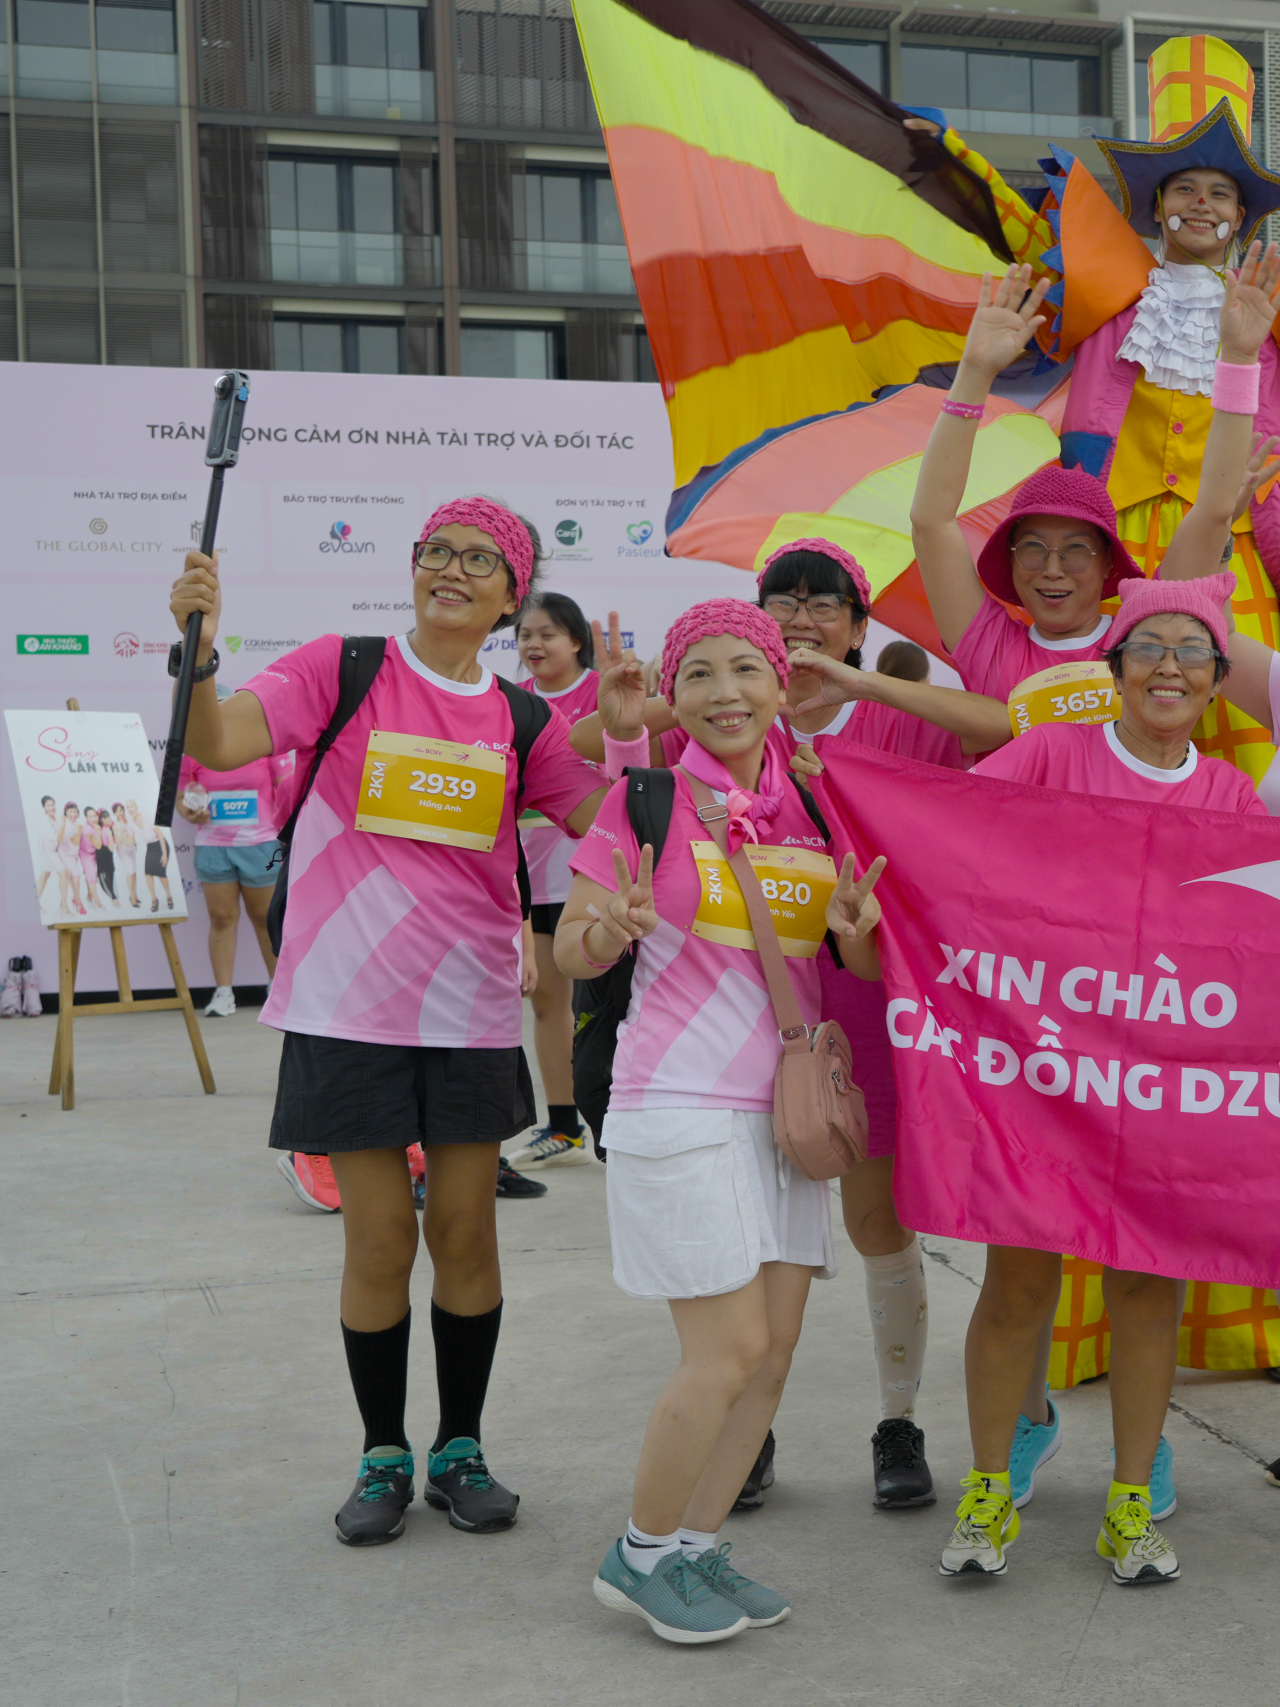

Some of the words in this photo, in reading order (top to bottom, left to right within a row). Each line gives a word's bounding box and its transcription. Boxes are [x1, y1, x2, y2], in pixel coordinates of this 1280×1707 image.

[147, 422, 205, 440] TRÂN
[240, 427, 287, 445] ỌNG
[294, 424, 341, 443] CẢM
[348, 428, 378, 444] ƠN
[386, 427, 431, 445] NHÀ
[437, 429, 467, 446] TÀI
[474, 431, 515, 450] TRỢ
[521, 430, 548, 447] VÀ
[554, 430, 590, 448] ĐỐI
[597, 432, 634, 449] TÁC
[74, 490, 96, 499] NHÀ
[99, 491, 114, 499] TÀI
[118, 491, 138, 501] TRỢ
[140, 492, 158, 501] ĐỊA
[283, 493, 305, 503] BẢO
[307, 495, 327, 505] TRỢ
[371, 496, 405, 504] THÔNG
[556, 499, 577, 507] ĐƠN
[35, 540, 62, 551] THE
[68, 541, 126, 552] GLOBAL
[131, 542, 163, 552] CITY
[319, 541, 375, 553] eva.vn
[618, 547, 662, 558] Pasteur
[353, 602, 370, 611] ĐỐI
[373, 603, 391, 611] TÁC
[394, 602, 415, 611] ĐỒN
[244, 639, 303, 648] CQUniversity
[1050, 688, 1113, 717] 3657
[102, 760, 130, 773] THỨ
[135, 763, 144, 773] 2
[368, 761, 387, 799] 2KM
[408, 770, 477, 800] 2939
[444, 803, 462, 813] Anh
[413, 828, 448, 839] PINKRUN
[707, 867, 722, 905] 2KM
[760, 879, 811, 905] 820
[936, 942, 1046, 1006] XIN
[1060, 952, 1238, 1029] CHÀO
[974, 1014, 1163, 1111] ĐỒNG
